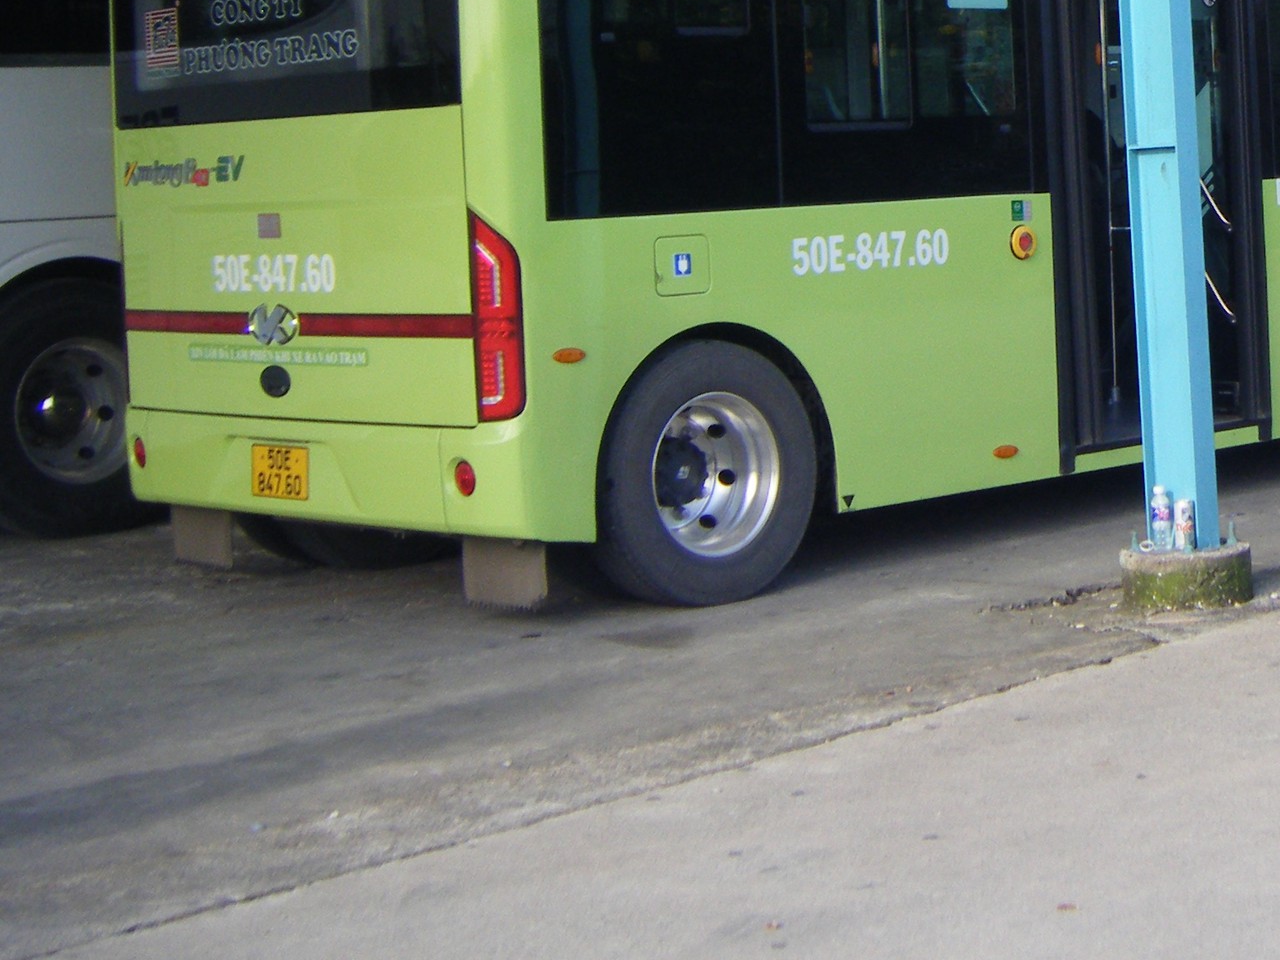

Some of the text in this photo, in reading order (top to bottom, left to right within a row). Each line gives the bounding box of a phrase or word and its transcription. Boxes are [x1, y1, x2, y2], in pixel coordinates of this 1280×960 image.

[184, 28, 359, 75] PHƯƠNG TRANG
[791, 227, 950, 277] 50E-847.60
[212, 253, 336, 293] 50E-847.60
[267, 448, 291, 470] 50E
[258, 472, 302, 496] 847.60
